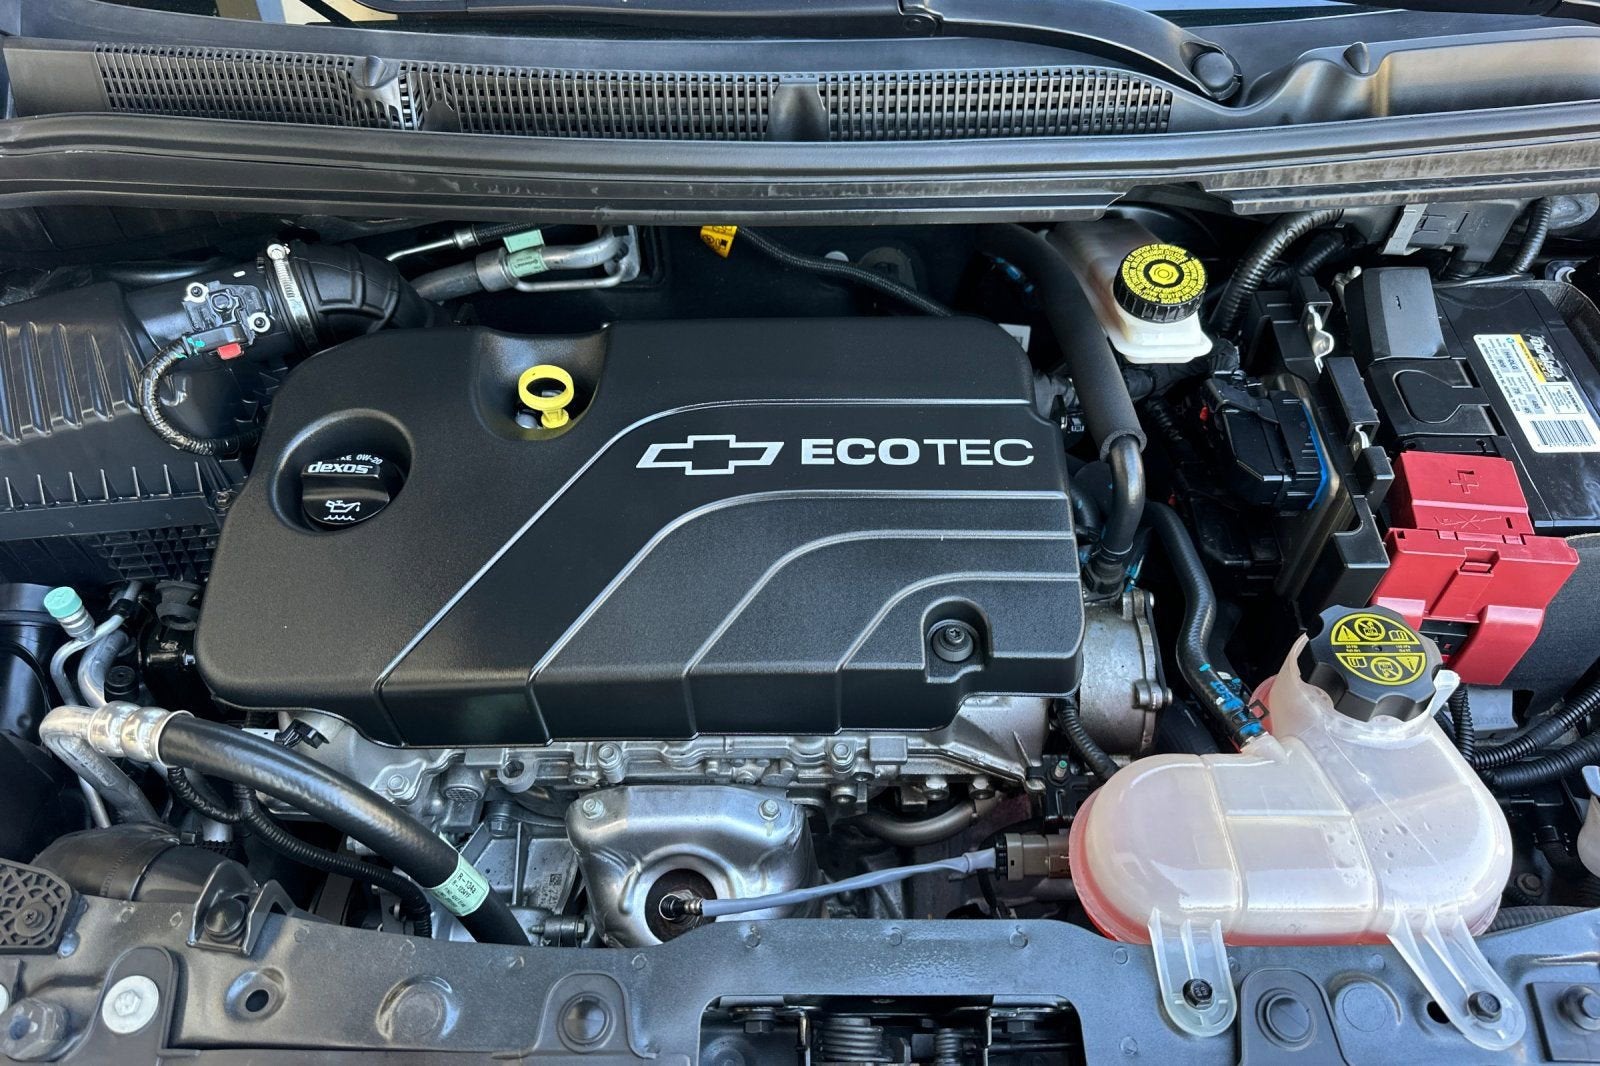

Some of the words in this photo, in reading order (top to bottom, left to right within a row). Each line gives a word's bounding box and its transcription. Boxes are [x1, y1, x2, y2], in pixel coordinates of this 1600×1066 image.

[800, 438, 1034, 466] ECOTEC
[356, 454, 383, 465] 0W-20
[308, 461, 373, 474] dexos
